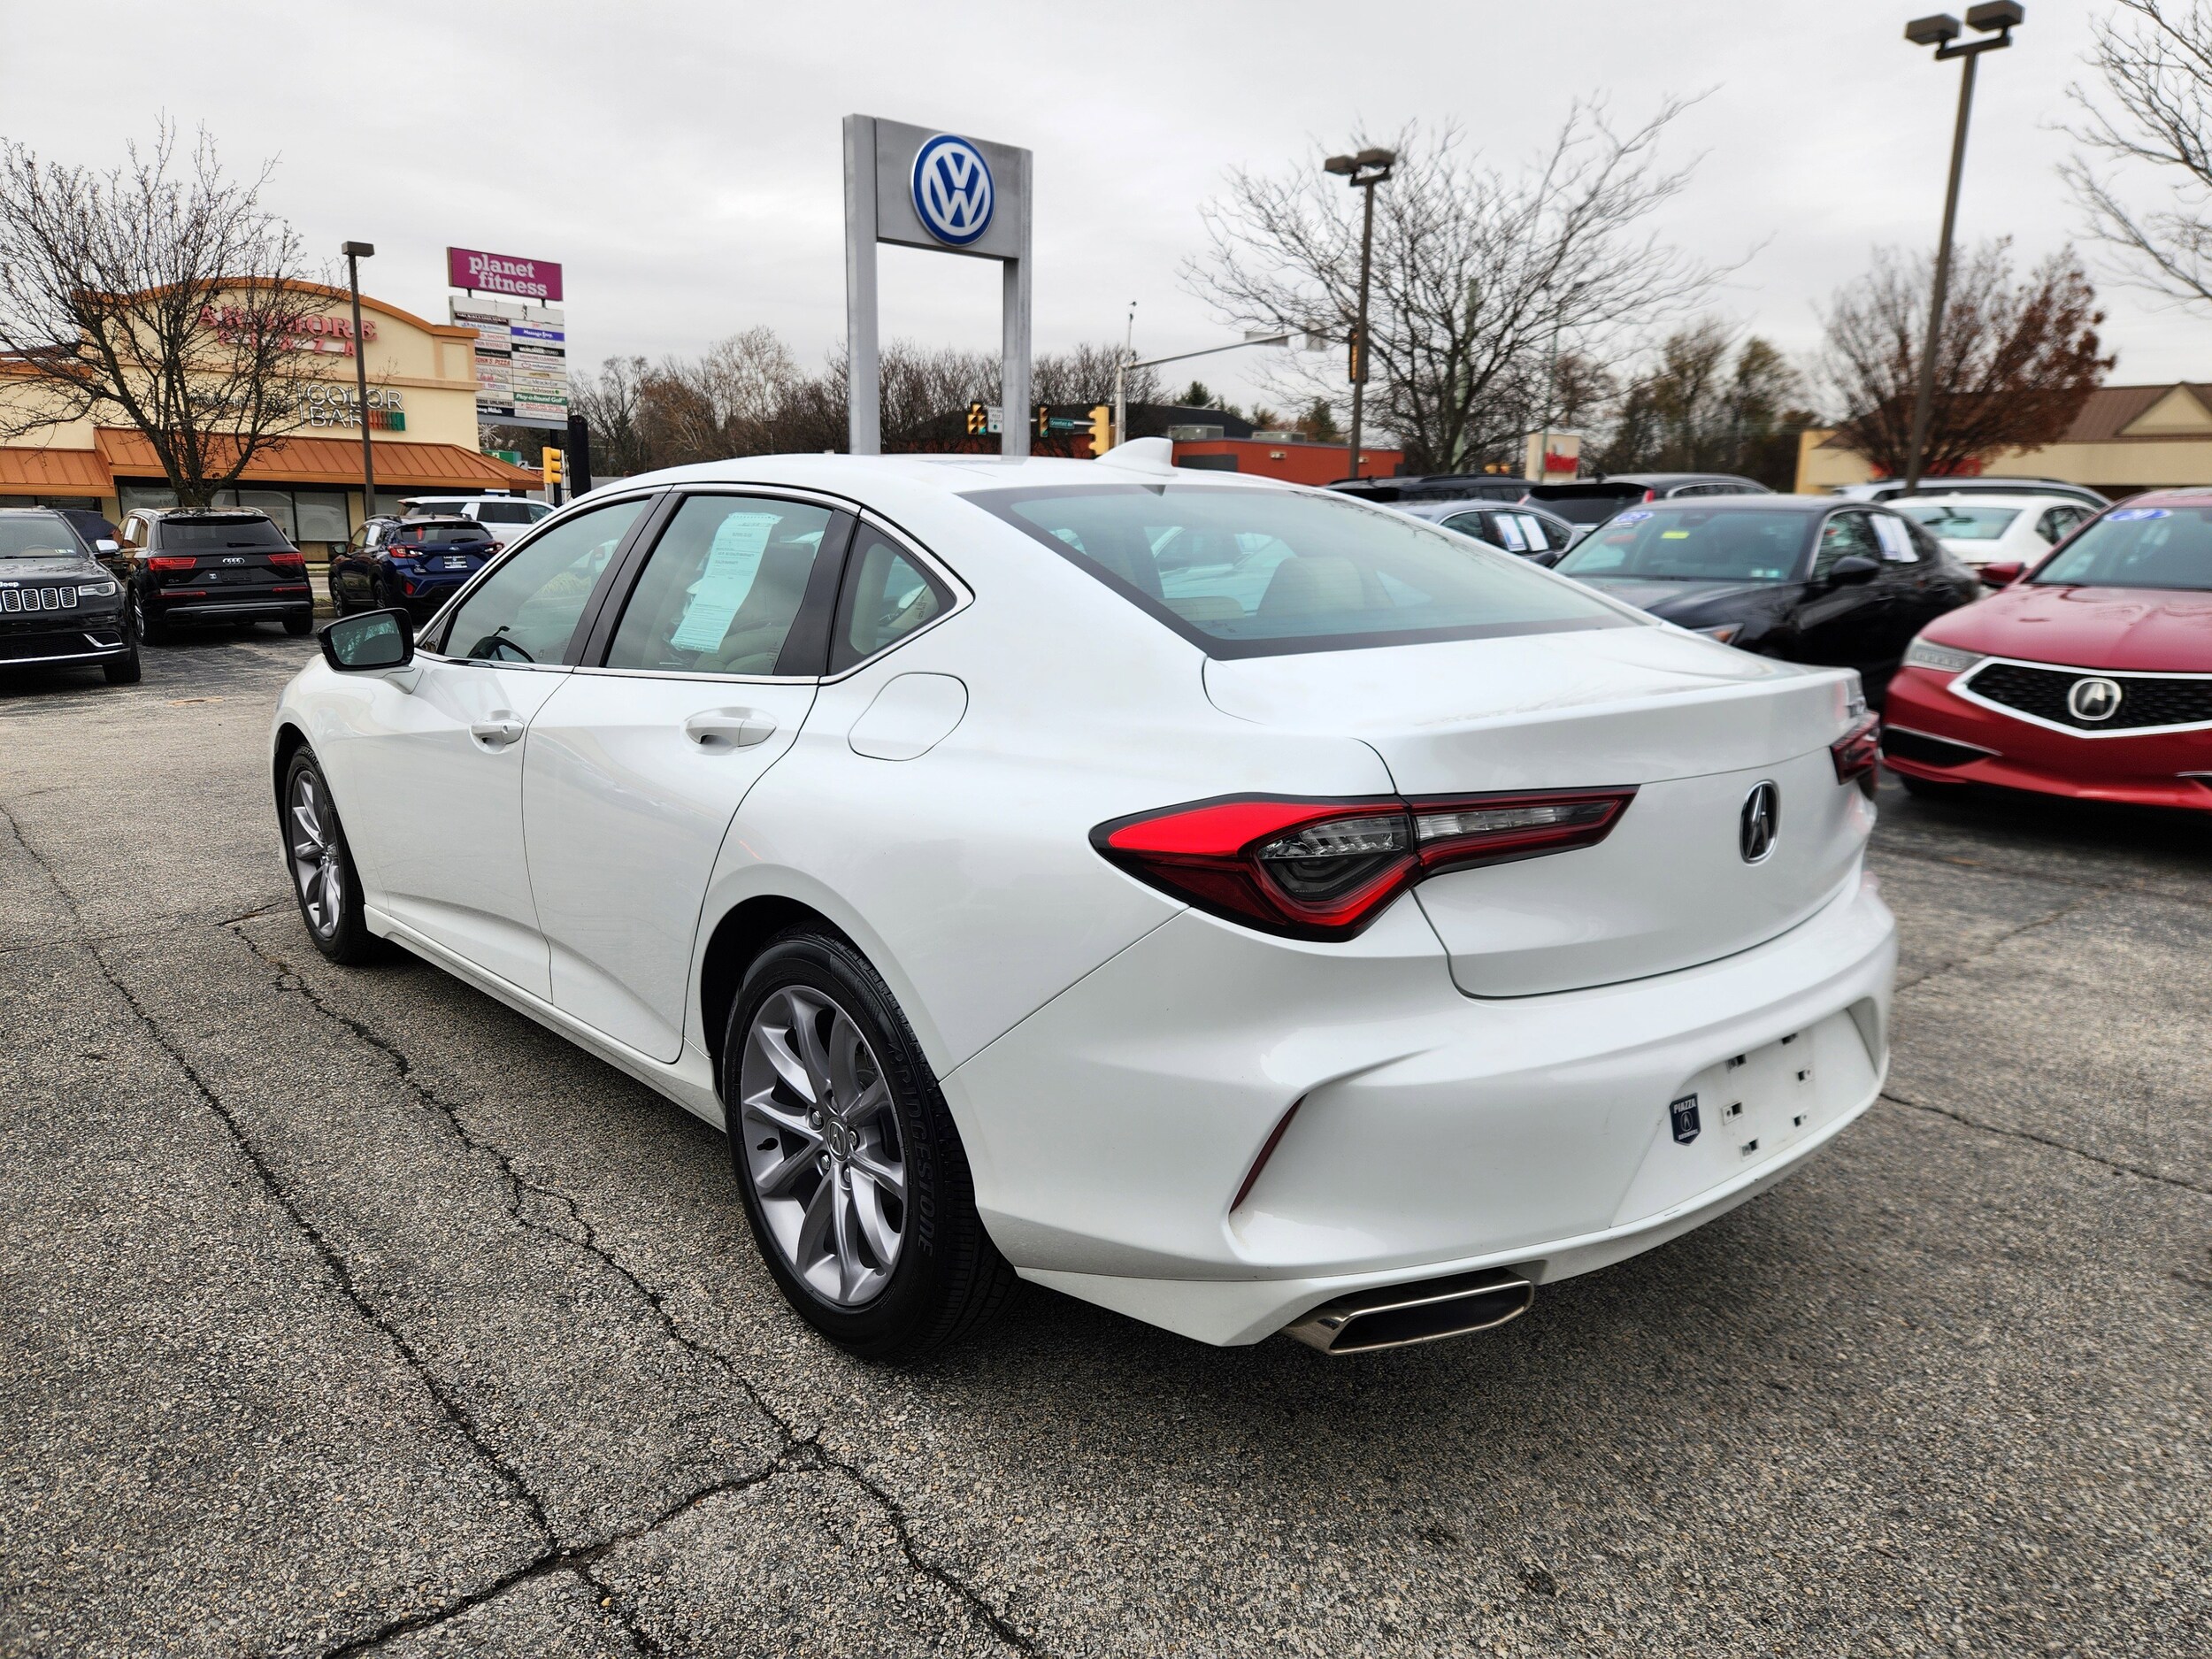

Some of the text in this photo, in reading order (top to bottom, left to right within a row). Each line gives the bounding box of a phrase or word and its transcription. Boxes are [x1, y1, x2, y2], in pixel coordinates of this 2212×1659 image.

[469, 254, 534, 279] planet
[479, 272, 548, 296] fitness
[198, 305, 378, 341] ARMORE
[307, 384, 404, 411] COLOR
[1673, 1098, 1696, 1114] PIAZZA
